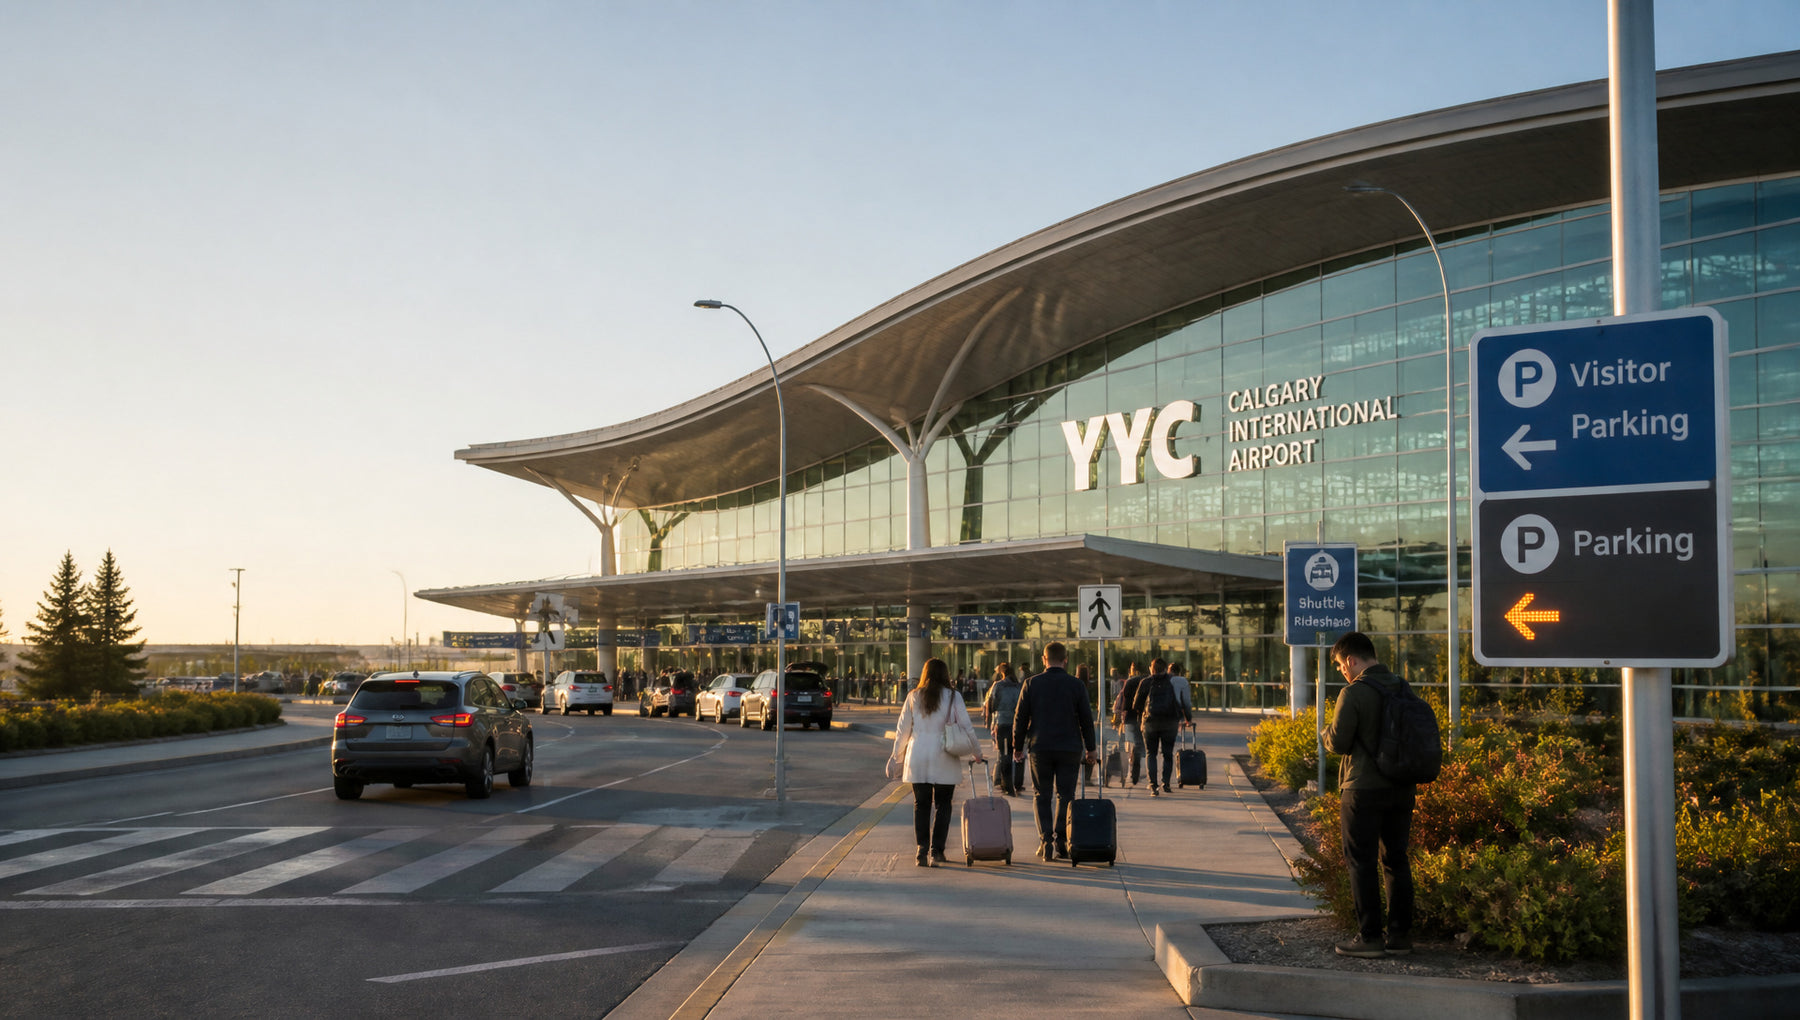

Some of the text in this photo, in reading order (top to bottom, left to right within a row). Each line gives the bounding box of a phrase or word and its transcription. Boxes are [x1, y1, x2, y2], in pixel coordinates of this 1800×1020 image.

[1515, 361, 1543, 398] P
[1570, 358, 1671, 388] Visitor
[1228, 375, 1324, 412] CALGARY
[1228, 396, 1397, 442] INTERNATIONAL
[1572, 409, 1689, 441] Parking
[1061, 400, 1200, 491] YYC
[1228, 439, 1316, 471] AIRPORT
[1517, 526, 1546, 563] P
[1574, 527, 1694, 561] Parking
[1298, 595, 1345, 609] Shuttle
